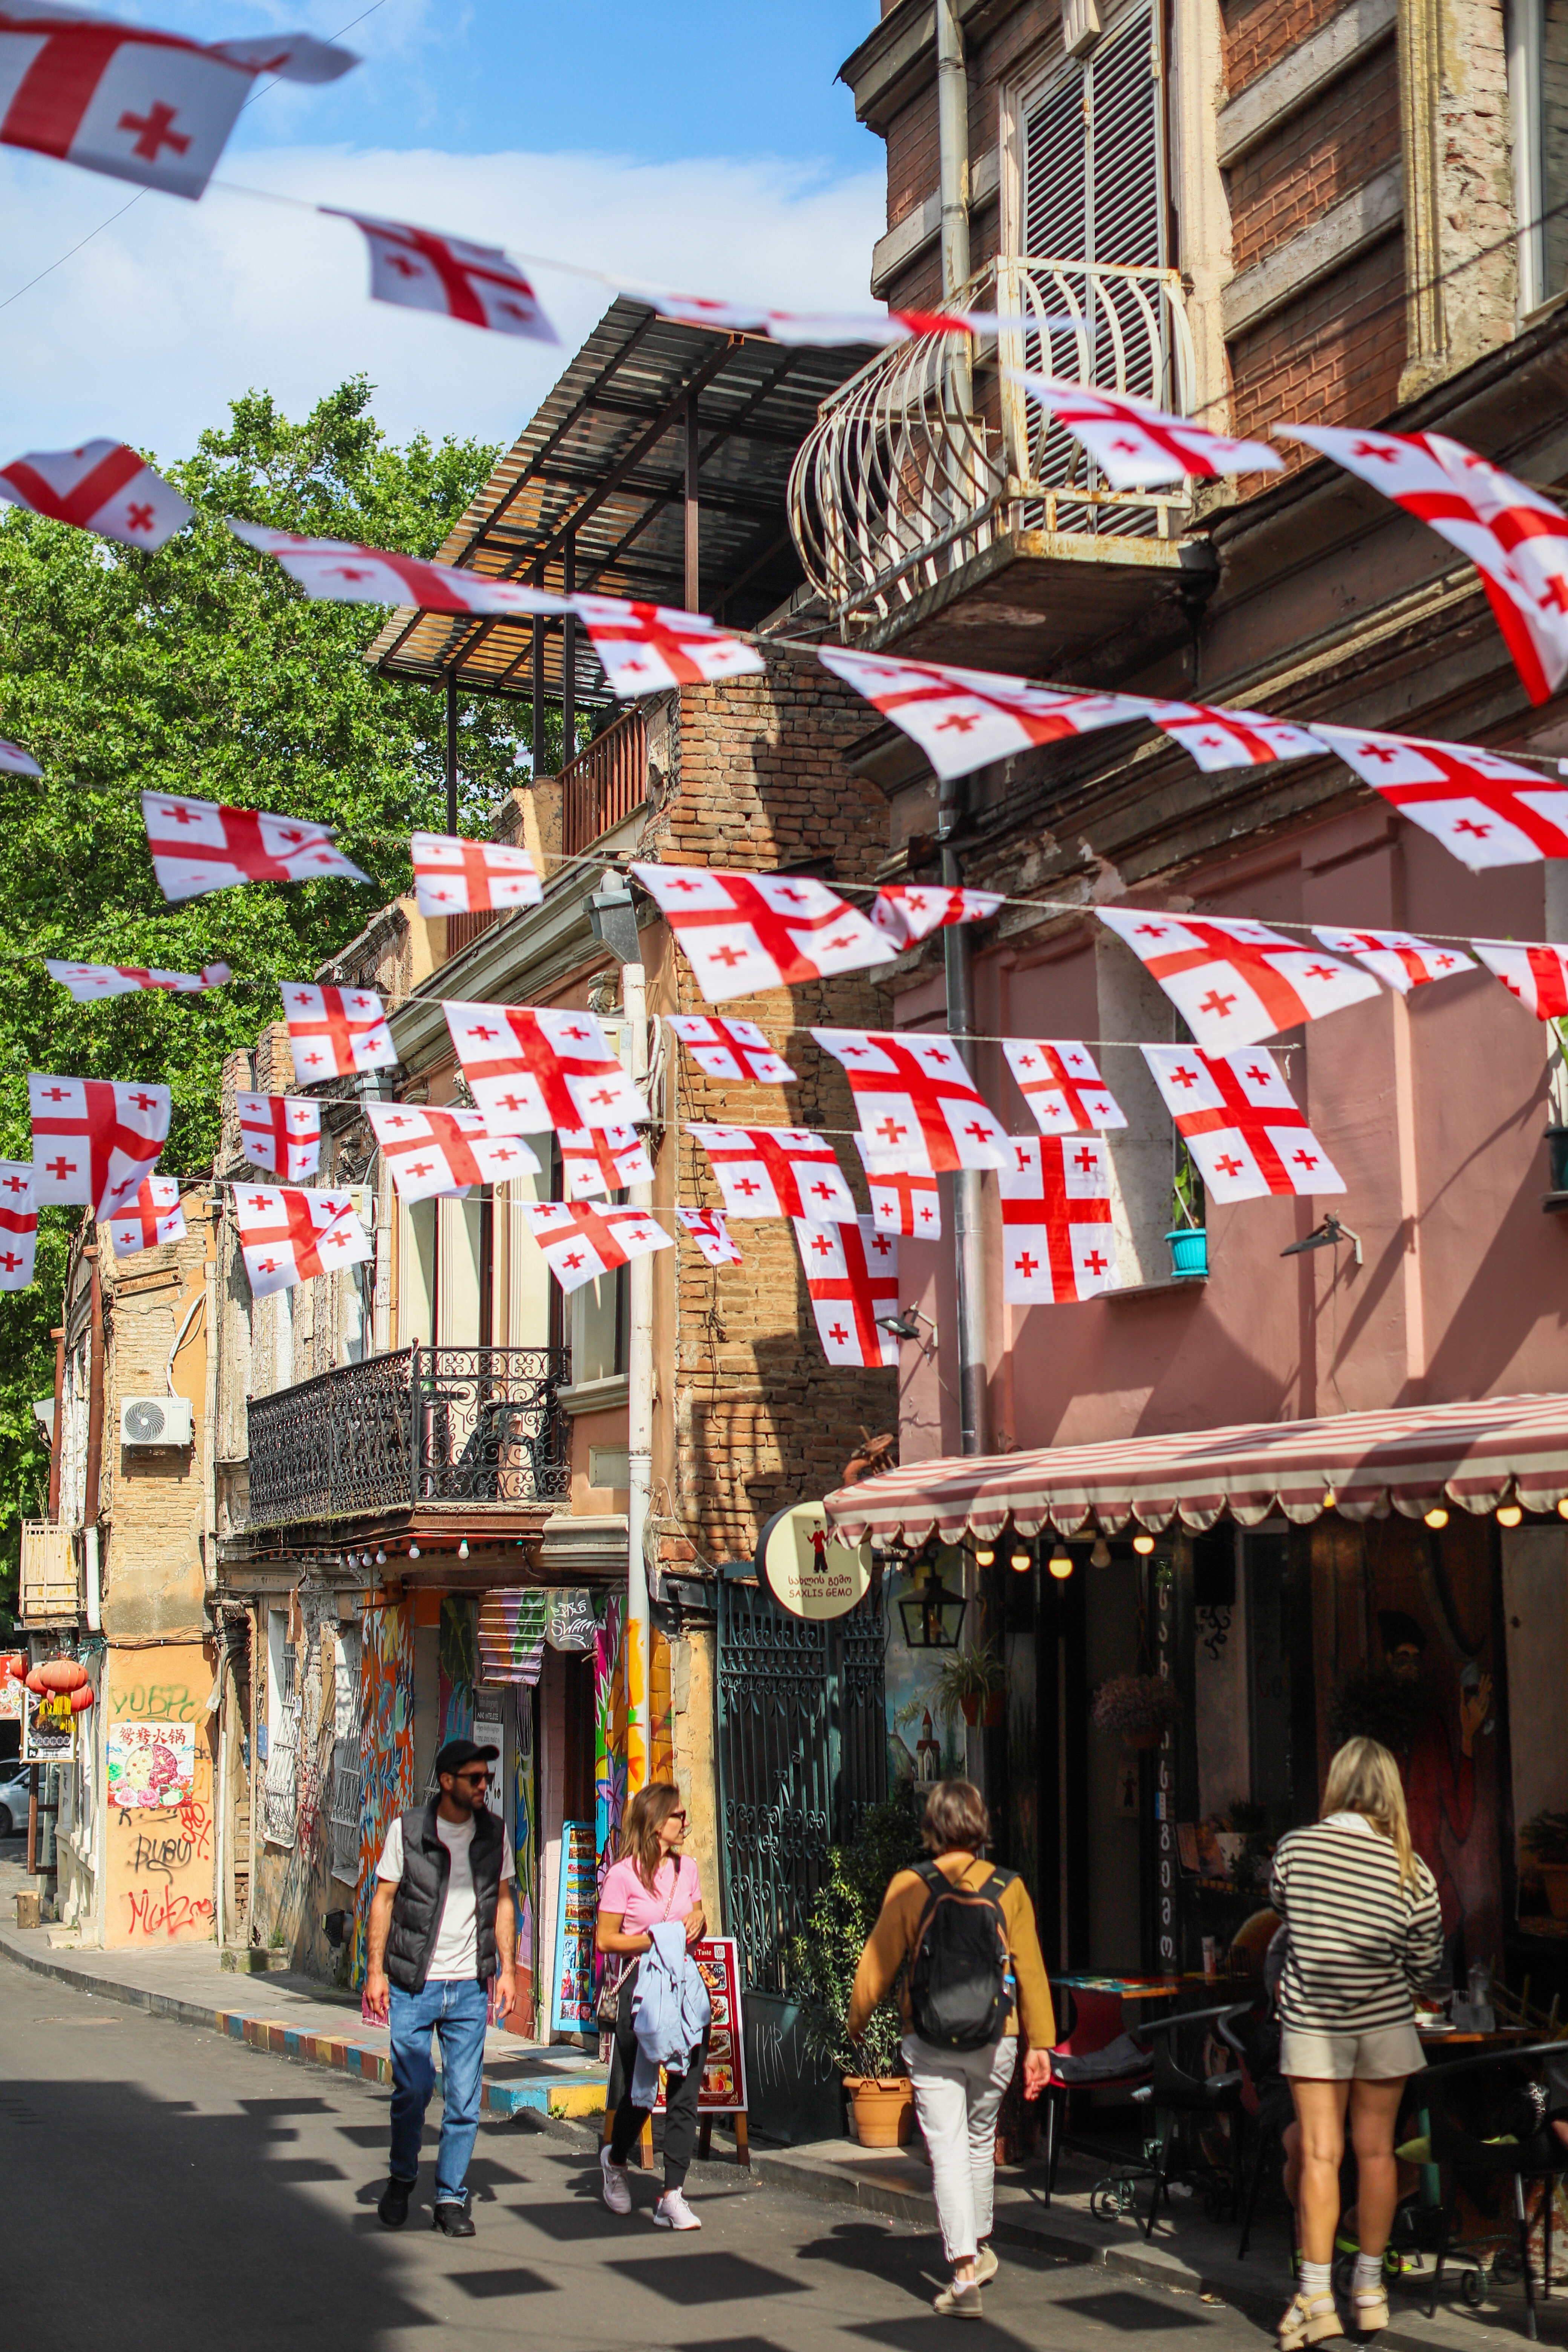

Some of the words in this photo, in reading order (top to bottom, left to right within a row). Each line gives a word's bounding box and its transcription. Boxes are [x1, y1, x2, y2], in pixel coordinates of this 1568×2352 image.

[788, 1575, 824, 1586] სახლის
[828, 1574, 852, 1585] გემო
[789, 1588, 824, 1598] SAXLIS
[826, 1587, 852, 1597] GEMO
[119, 1727, 186, 1746] 鸳鸯火锅
